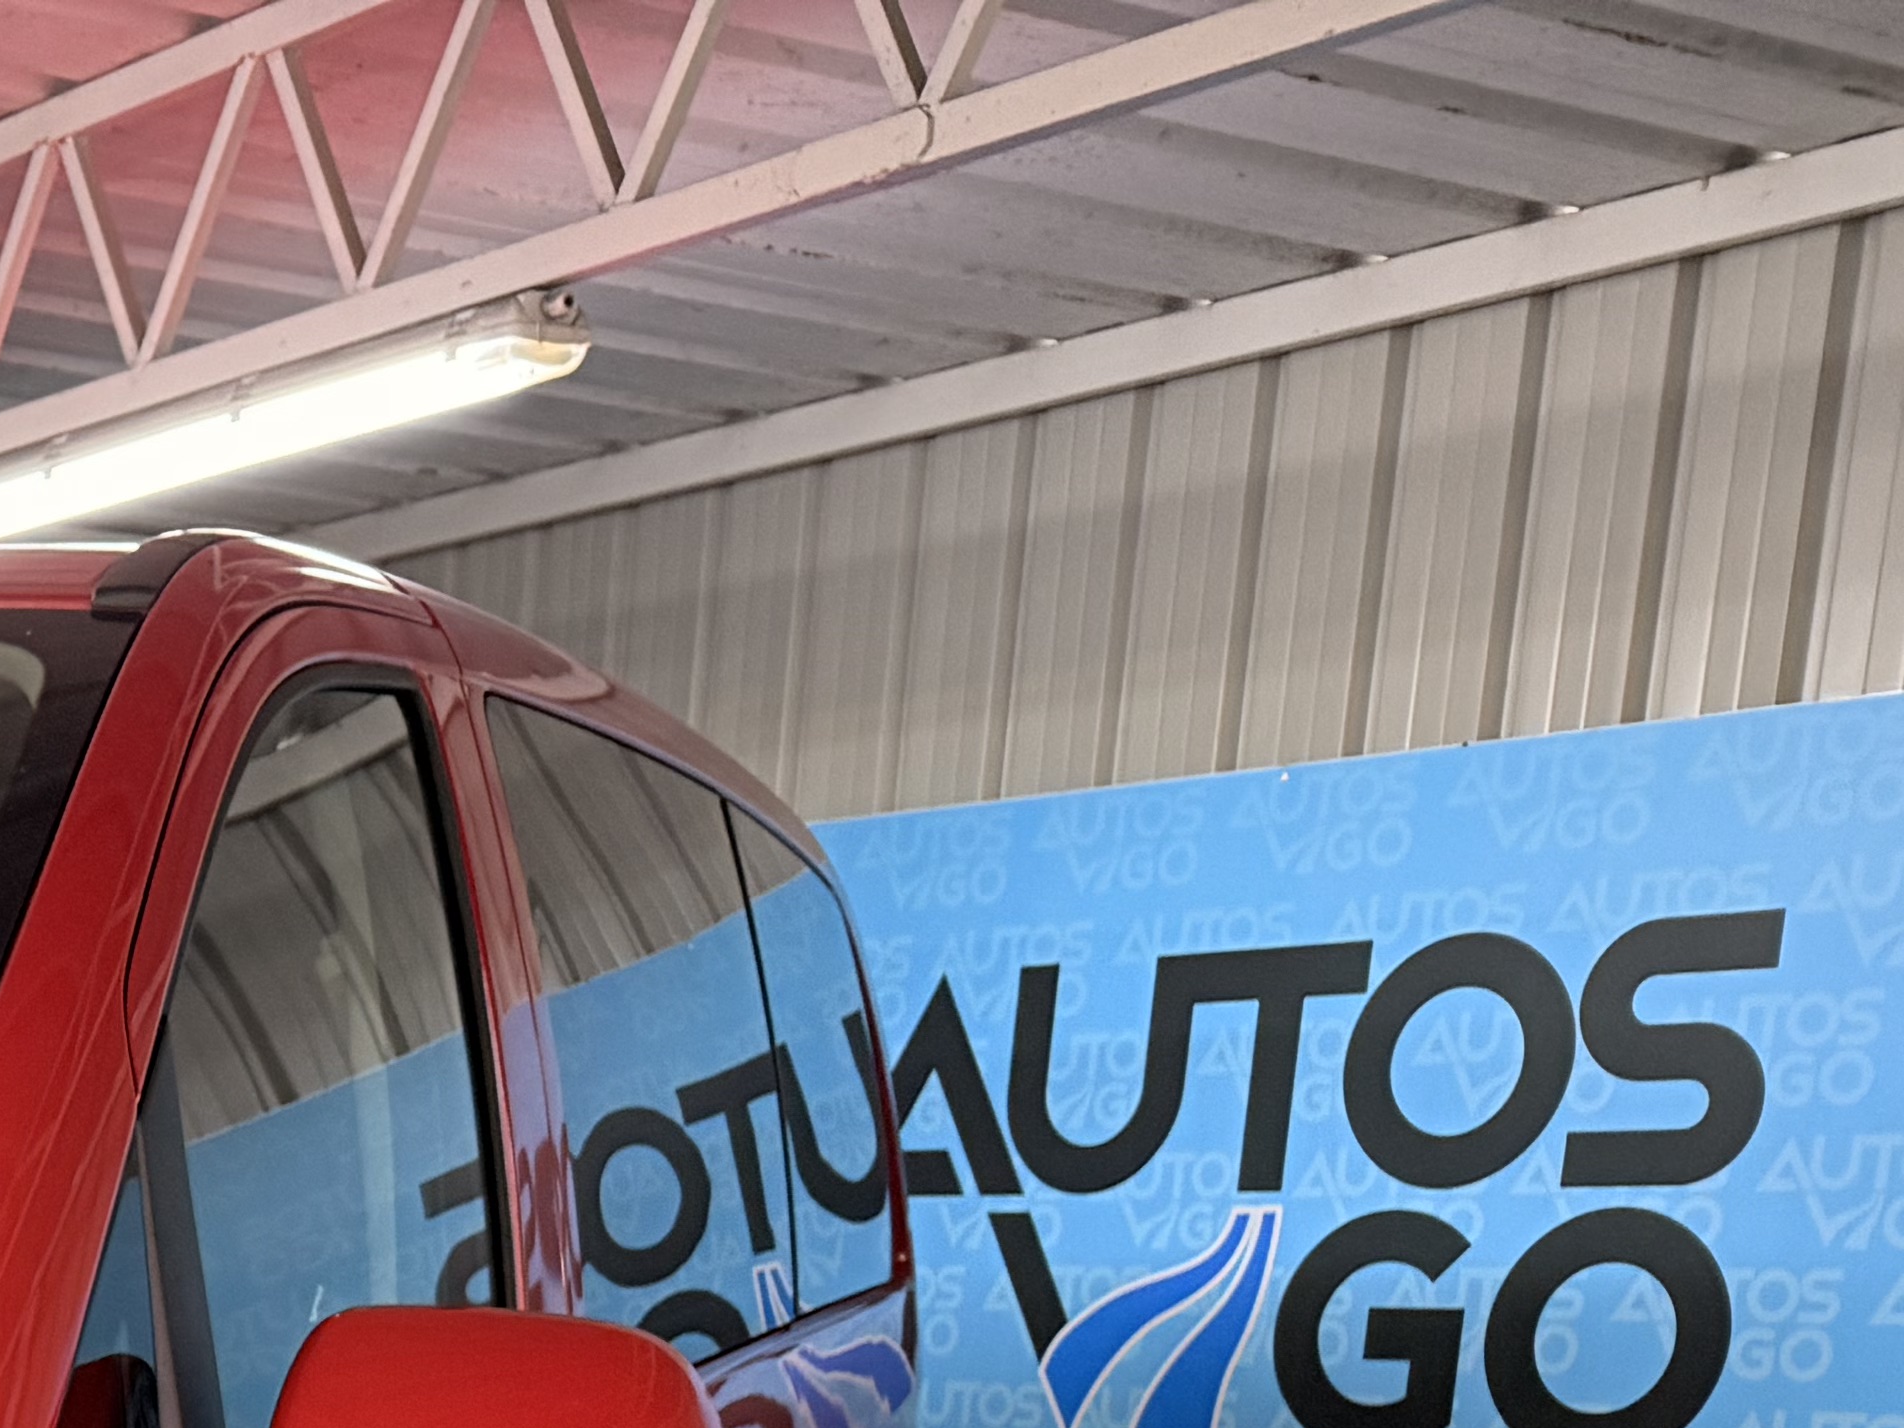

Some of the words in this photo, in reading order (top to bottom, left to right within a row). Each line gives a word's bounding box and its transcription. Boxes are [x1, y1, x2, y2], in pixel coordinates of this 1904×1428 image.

[1230, 761, 1419, 829] AUTOS
[1447, 733, 1660, 807] AUTOS
[856, 811, 1014, 868] AUTOS
[1033, 788, 1203, 850] AUTOS
[1332, 880, 1528, 940] AUTOS
[1546, 861, 1770, 933] AUTOS
[893, 907, 1786, 1194] AUTOS
